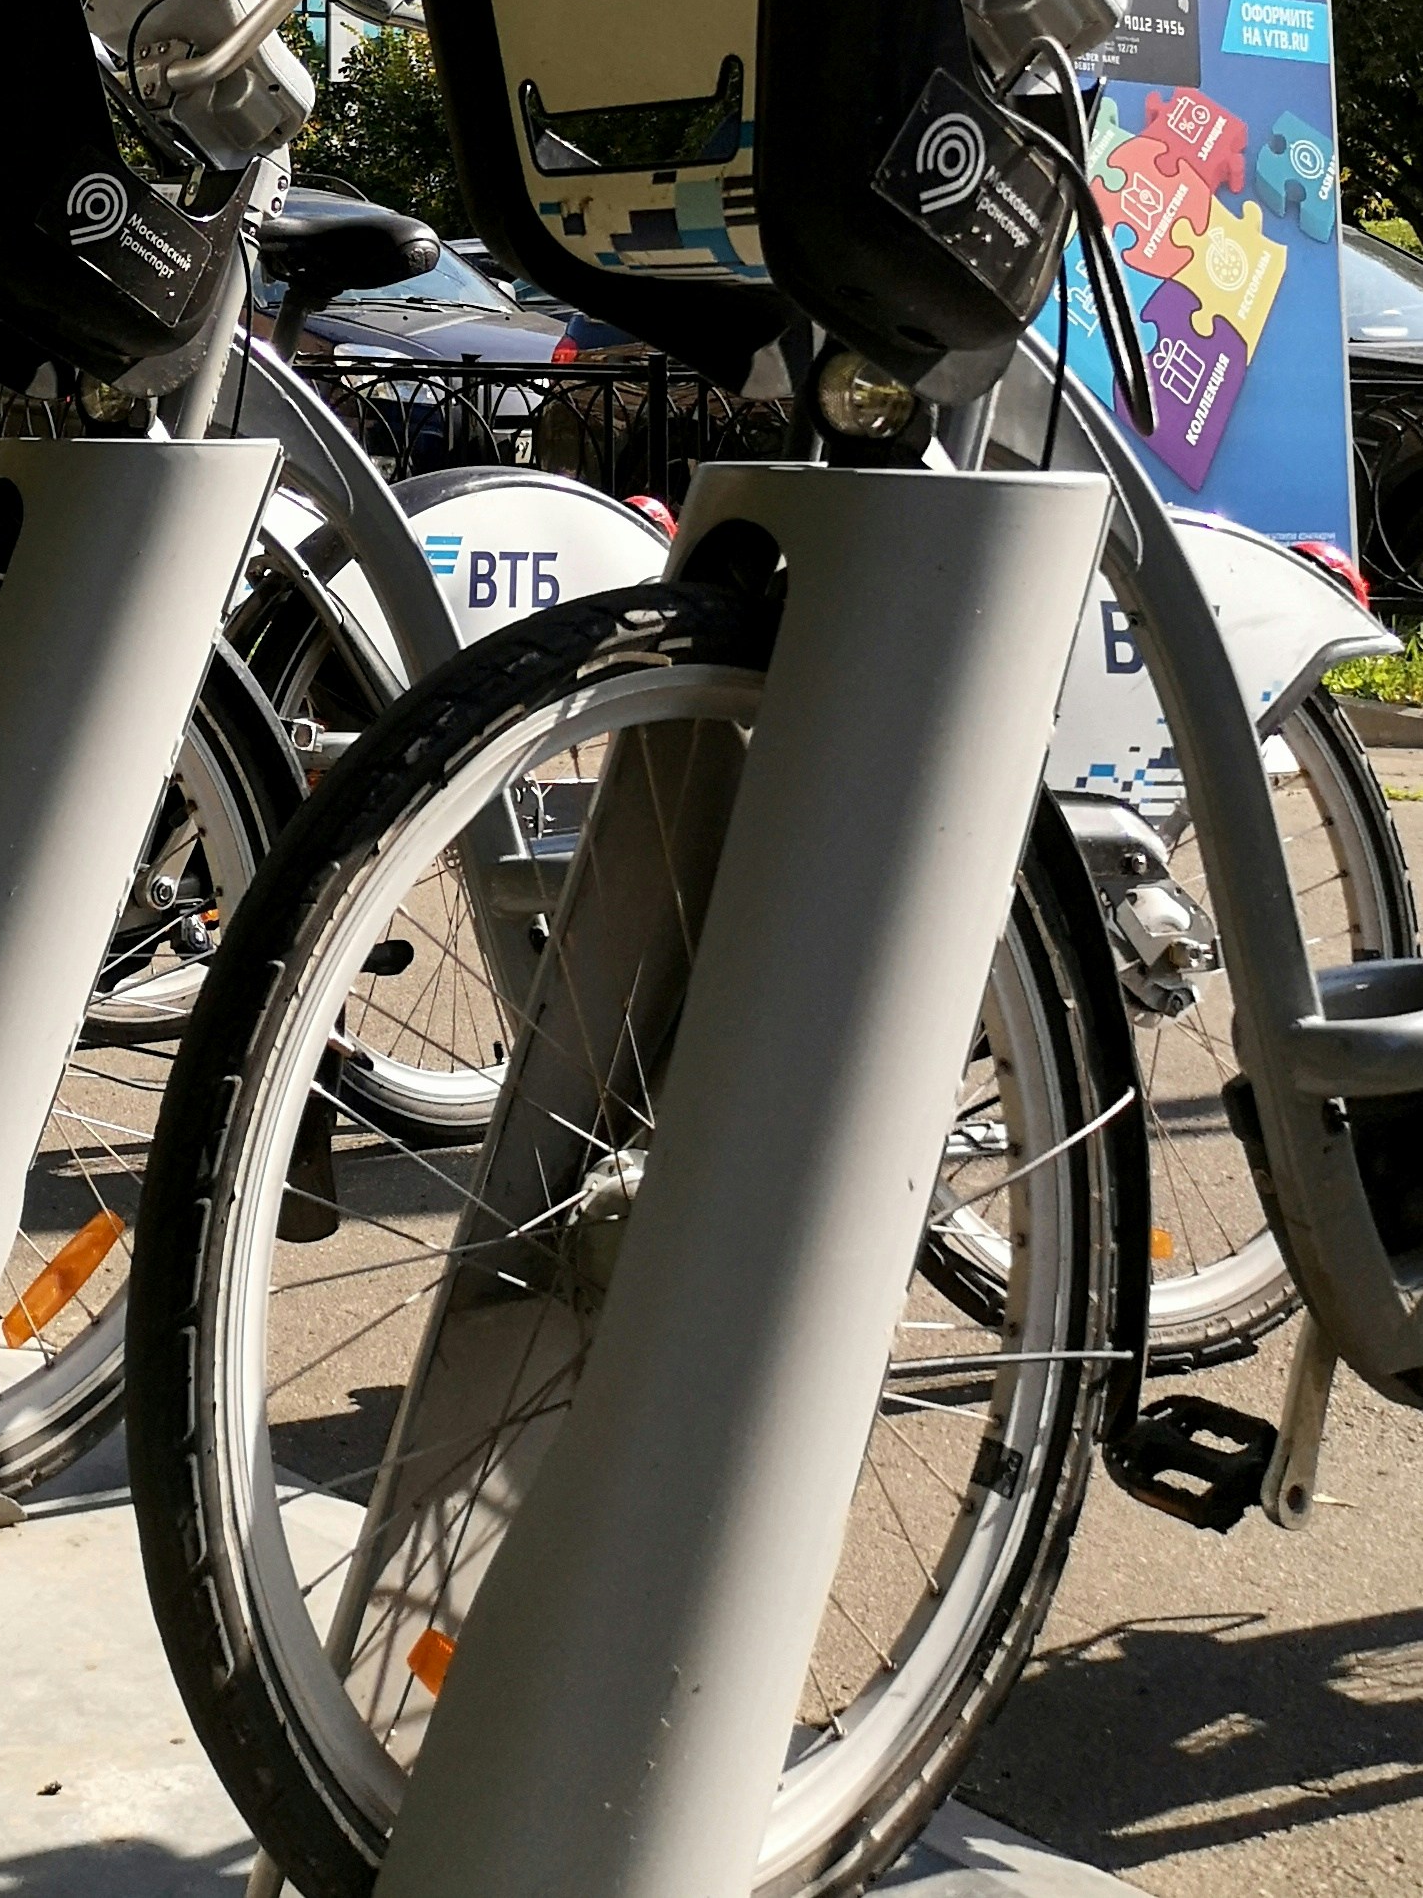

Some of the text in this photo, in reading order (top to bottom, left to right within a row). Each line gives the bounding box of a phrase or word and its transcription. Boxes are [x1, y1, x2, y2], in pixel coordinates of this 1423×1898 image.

[1124, 15, 1152, 32] 9012
[1155, 18, 1185, 36] 3456
[1241, 2, 1315, 30] ОФОРМИТЕ
[1242, 26, 1309, 52] НА VTB.RU
[1117, 43, 1138, 54] 12/21
[127, 213, 192, 272] Московский
[1143, 183, 1189, 258] ПУТЕШЕСТВИЯ
[119, 227, 175, 279] Транспорт
[1237, 251, 1272, 320] РЕСТОРАНЫ
[1185, 353, 1230, 446] КОЛЛЕКЦИЯ
[468, 551, 561, 609] ВТБ
